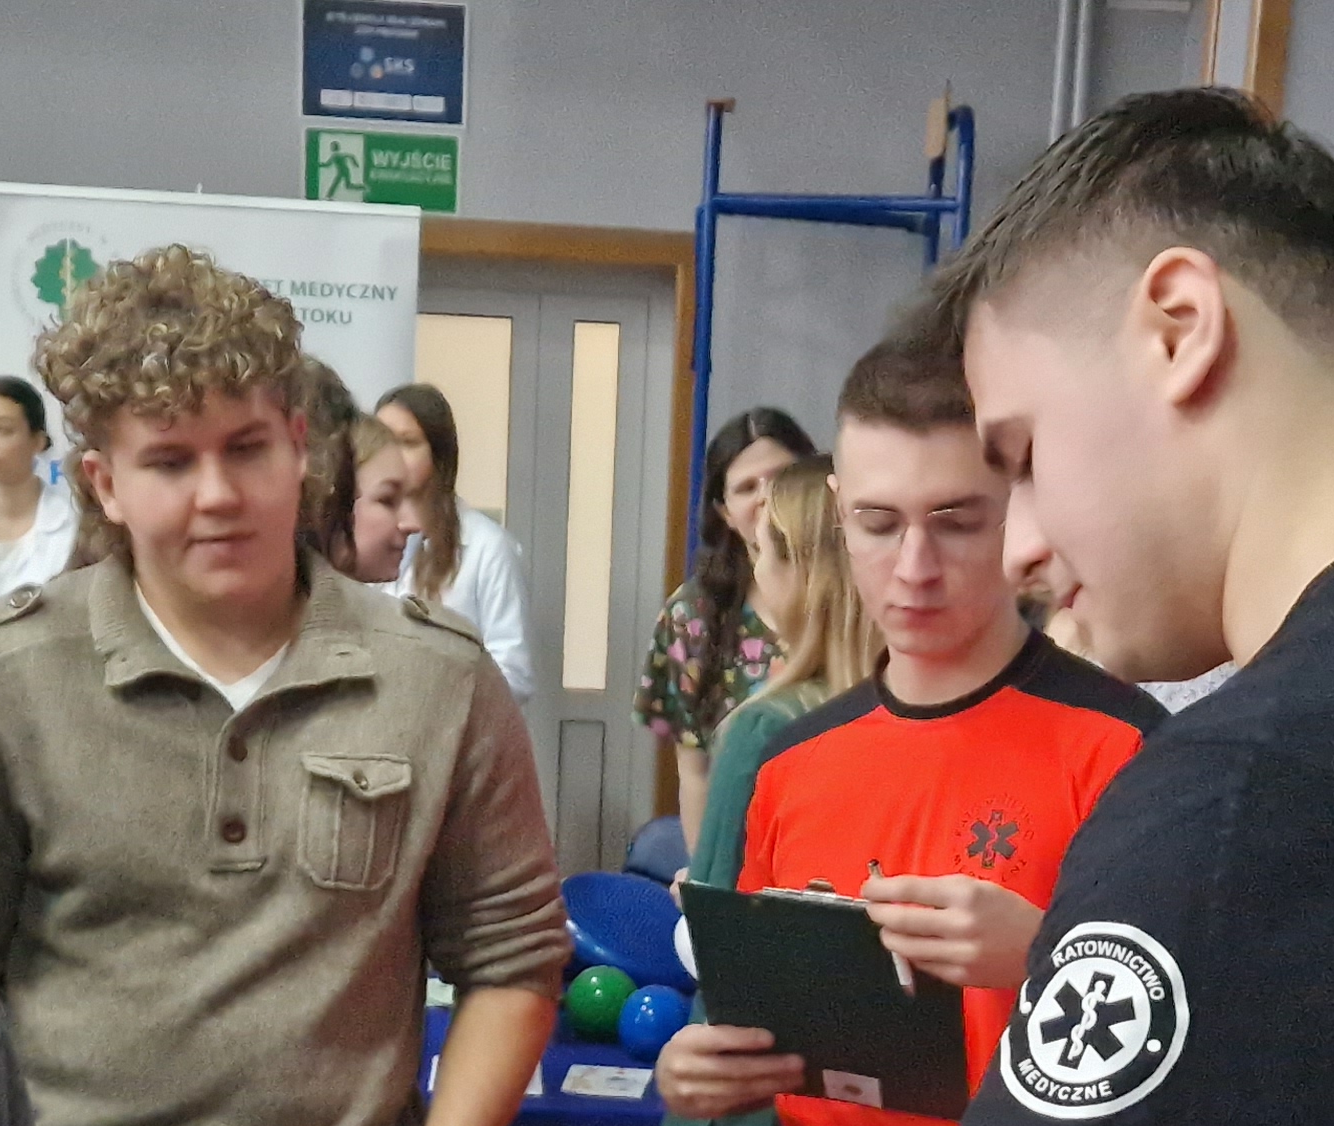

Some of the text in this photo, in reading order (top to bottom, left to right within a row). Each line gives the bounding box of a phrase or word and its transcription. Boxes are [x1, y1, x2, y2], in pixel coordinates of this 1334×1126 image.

[290, 280, 399, 301] MEDYCZNY
[1051, 940, 1166, 1001] RATOWNICTWO
[1018, 1058, 1113, 1101] MEDYCZNE
